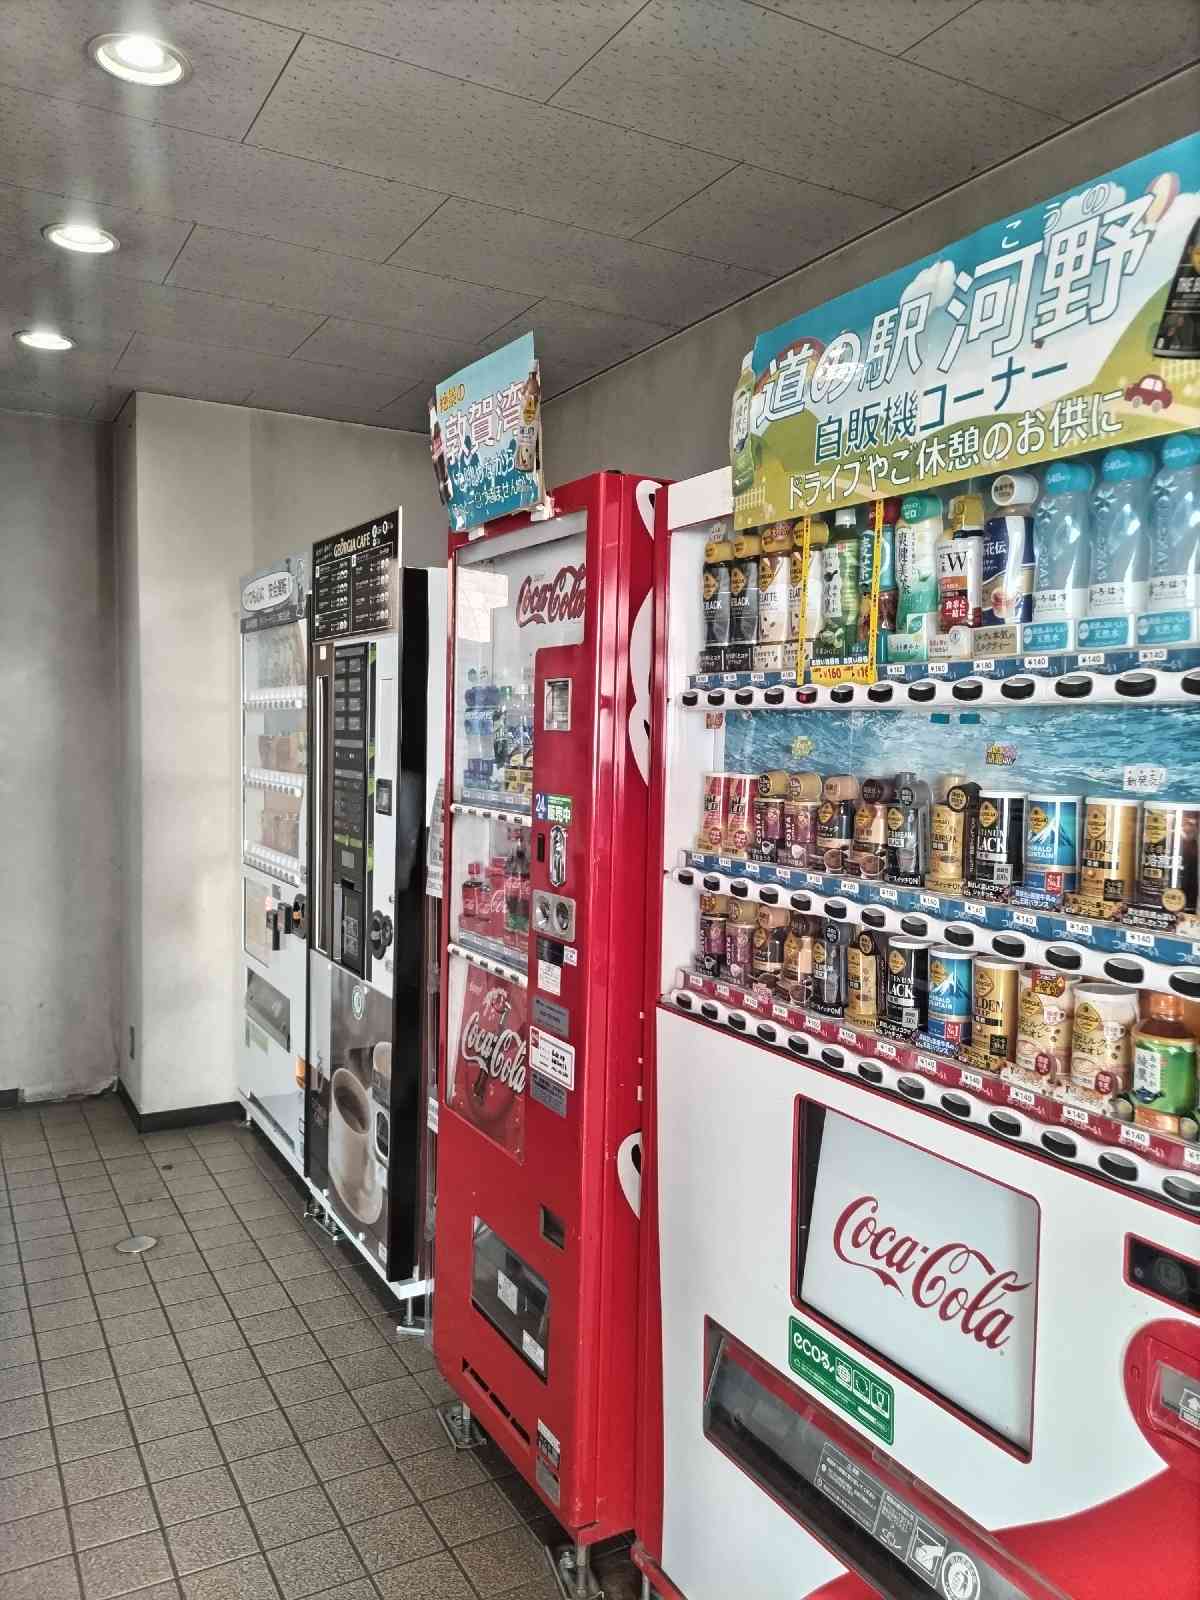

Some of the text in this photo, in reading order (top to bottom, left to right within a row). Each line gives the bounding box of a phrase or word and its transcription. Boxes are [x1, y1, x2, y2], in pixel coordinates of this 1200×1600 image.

[1002, 182, 1110, 250] こうの
[813, 354, 1069, 467] 自販機コーナー
[789, 388, 1124, 512] ドライブやご休憩のお供に
[356, 531, 371, 550] CAFE
[946, 552, 968, 572] W
[516, 562, 587, 629] Coca-Cola
[1028, 656, 1046, 666] ¥140
[1081, 654, 1101, 664] ¥140
[535, 793, 547, 813] 24
[1069, 922, 1089, 933] ¥140
[1129, 933, 1151, 944] ¥140
[462, 1011, 526, 1094] Coca-Cola
[1014, 1090, 1032, 1103] ¥140
[1066, 1109, 1085, 1121] ¥140
[1124, 1129, 1146, 1142] ¥140
[832, 1195, 1032, 1351] Coca-Cola
